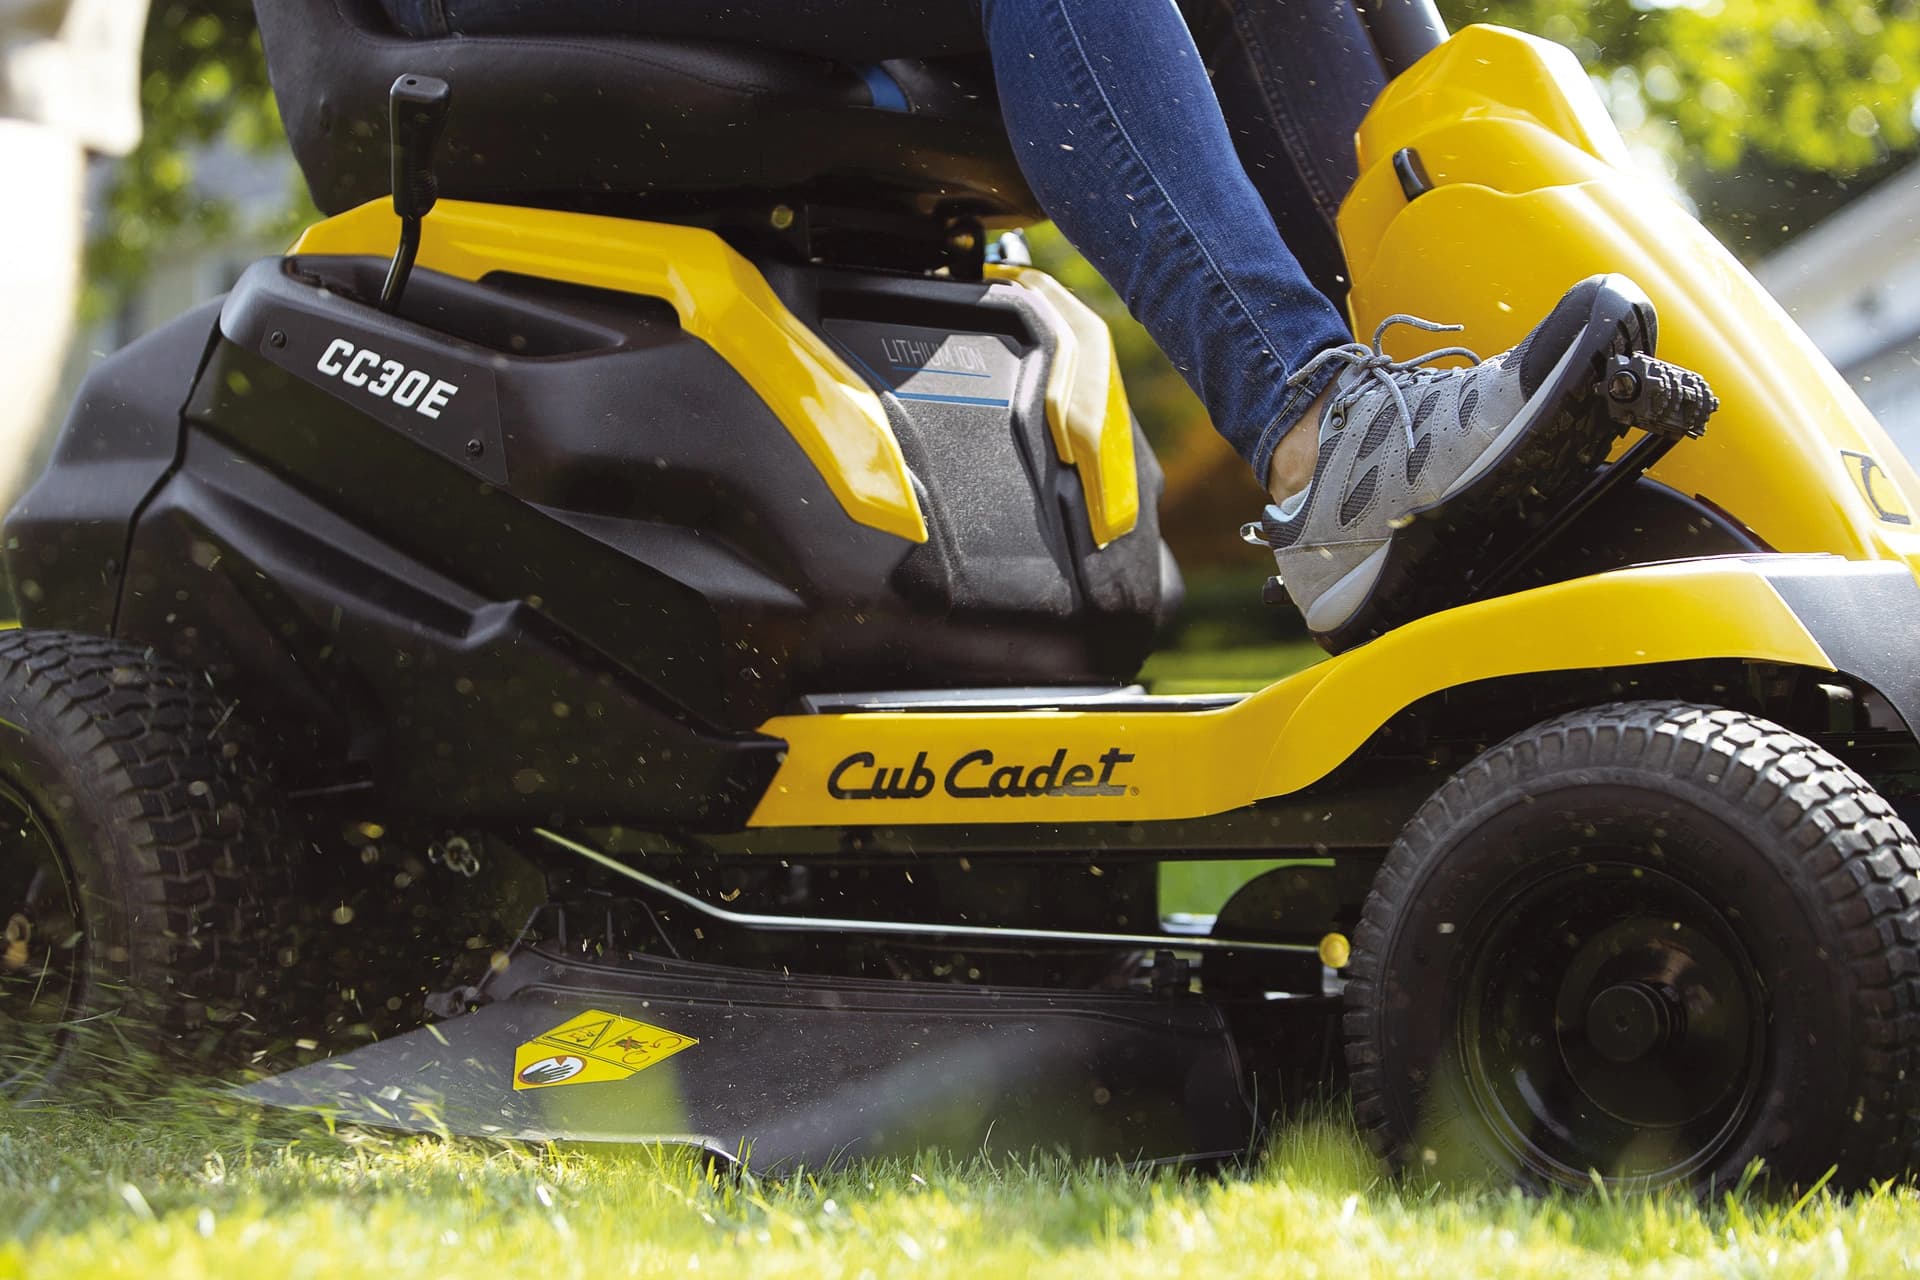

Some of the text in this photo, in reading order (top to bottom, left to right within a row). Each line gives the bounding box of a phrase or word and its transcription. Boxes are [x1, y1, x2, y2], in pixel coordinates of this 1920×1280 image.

[317, 338, 459, 420] CC30E
[881, 337, 987, 371] LITHIUM ION
[827, 747, 1136, 800] Cub Cadet
